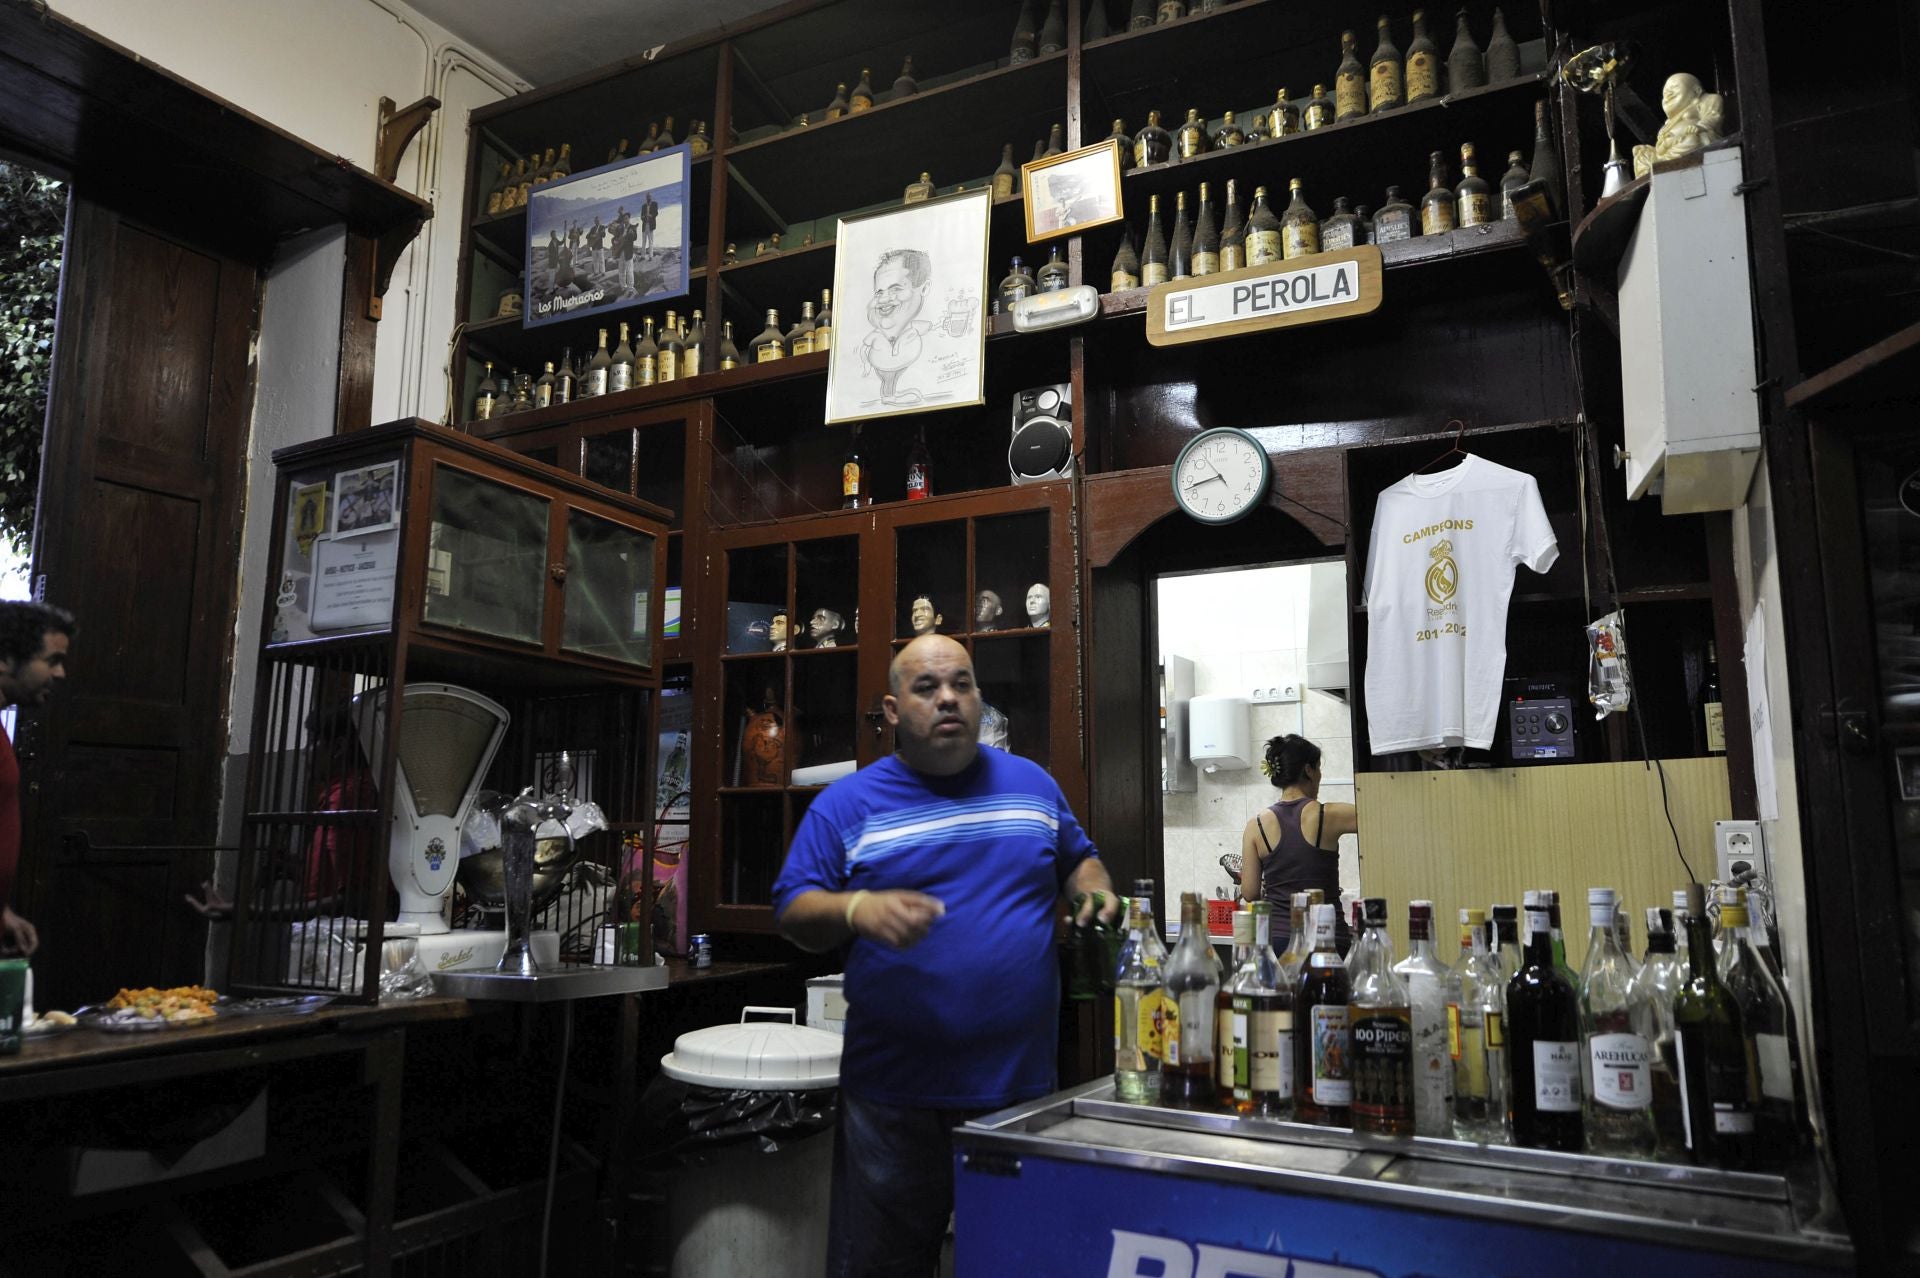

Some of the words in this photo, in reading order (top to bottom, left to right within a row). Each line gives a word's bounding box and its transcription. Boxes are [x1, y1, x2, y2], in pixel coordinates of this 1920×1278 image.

[1169, 295, 1205, 325] EL
[1233, 268, 1351, 315] PEROLA
[538, 300, 552, 313] Los
[1204, 448, 1212, 458] 11
[1216, 441, 1226, 453] 12
[1192, 459, 1206, 470] 10
[1355, 1028, 1374, 1041] 100
